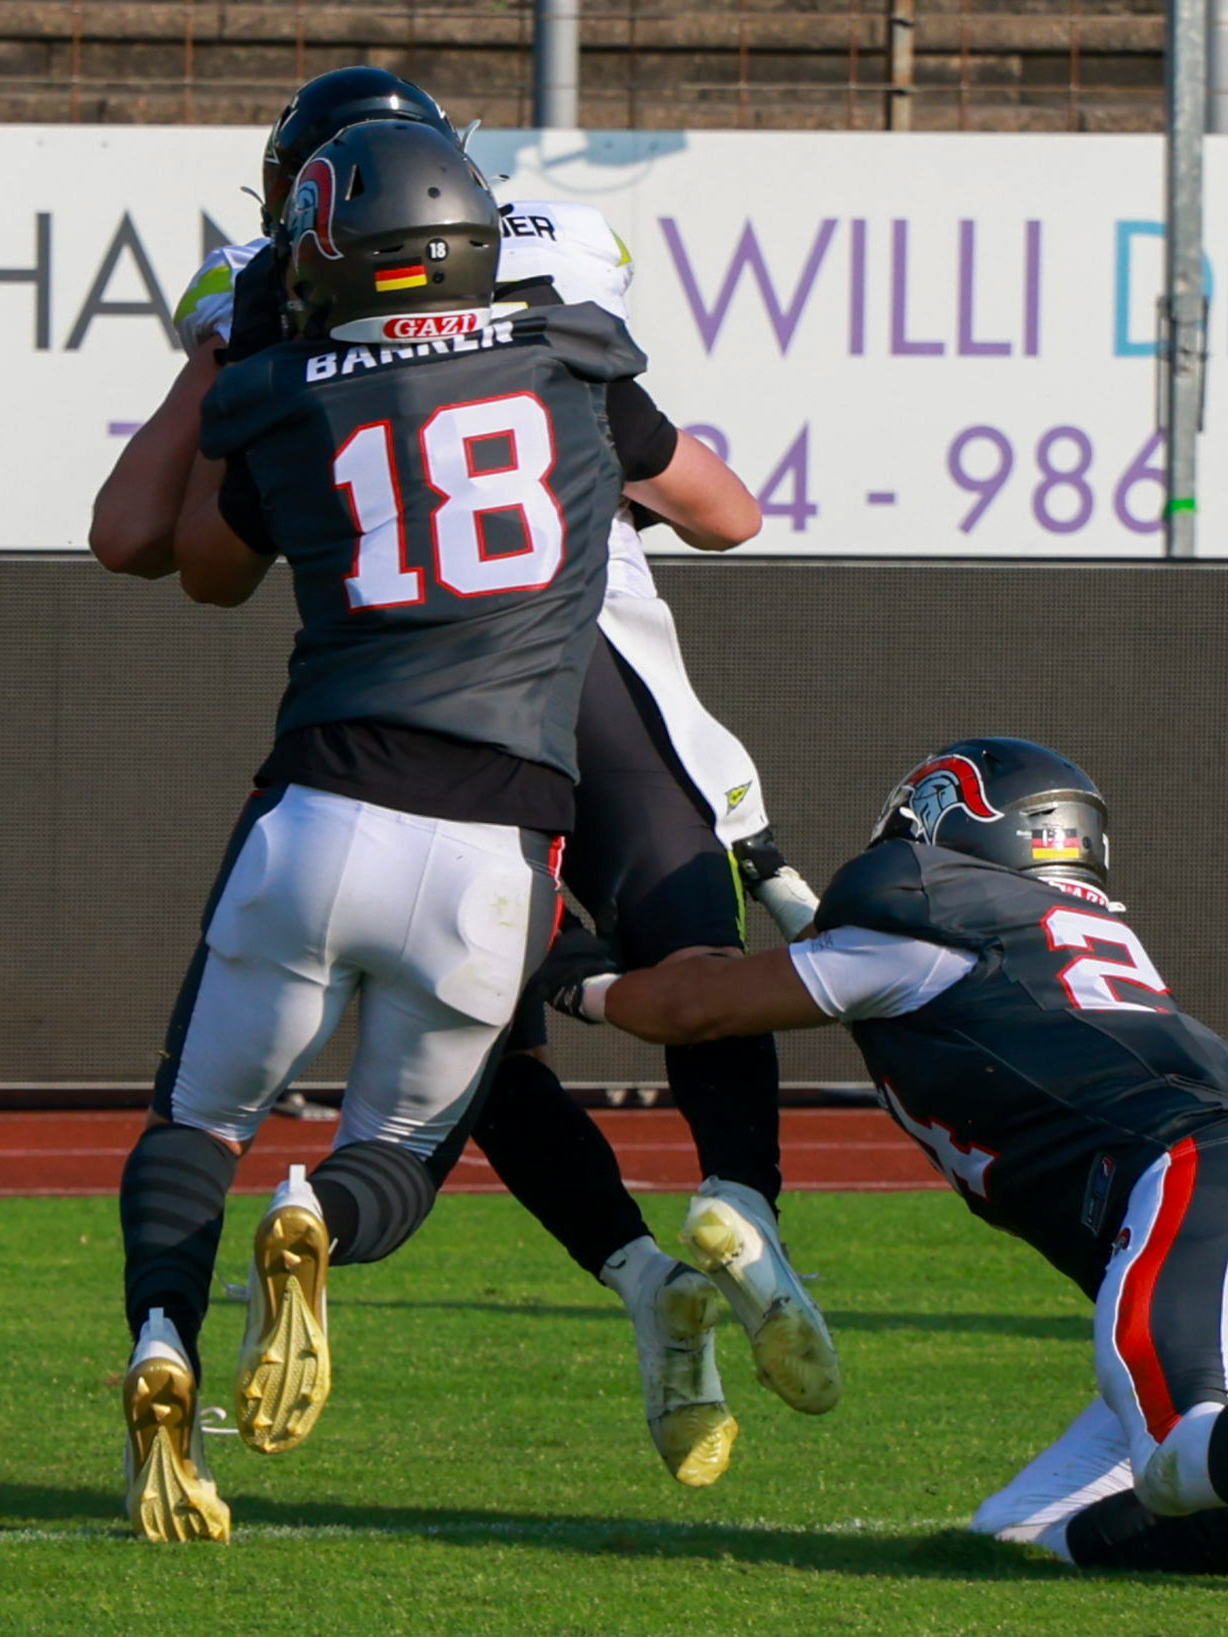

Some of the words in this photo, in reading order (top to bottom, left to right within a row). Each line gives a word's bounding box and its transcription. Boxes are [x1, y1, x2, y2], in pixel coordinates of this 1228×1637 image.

[0, 210, 236, 352] HA
[658, 217, 1041, 356] WILLI
[428, 242, 447, 259] 18
[393, 313, 474, 339] GAZI
[329, 390, 568, 614] 18
[947, 425, 1166, 534] 986
[1039, 905, 1173, 1014] 2
